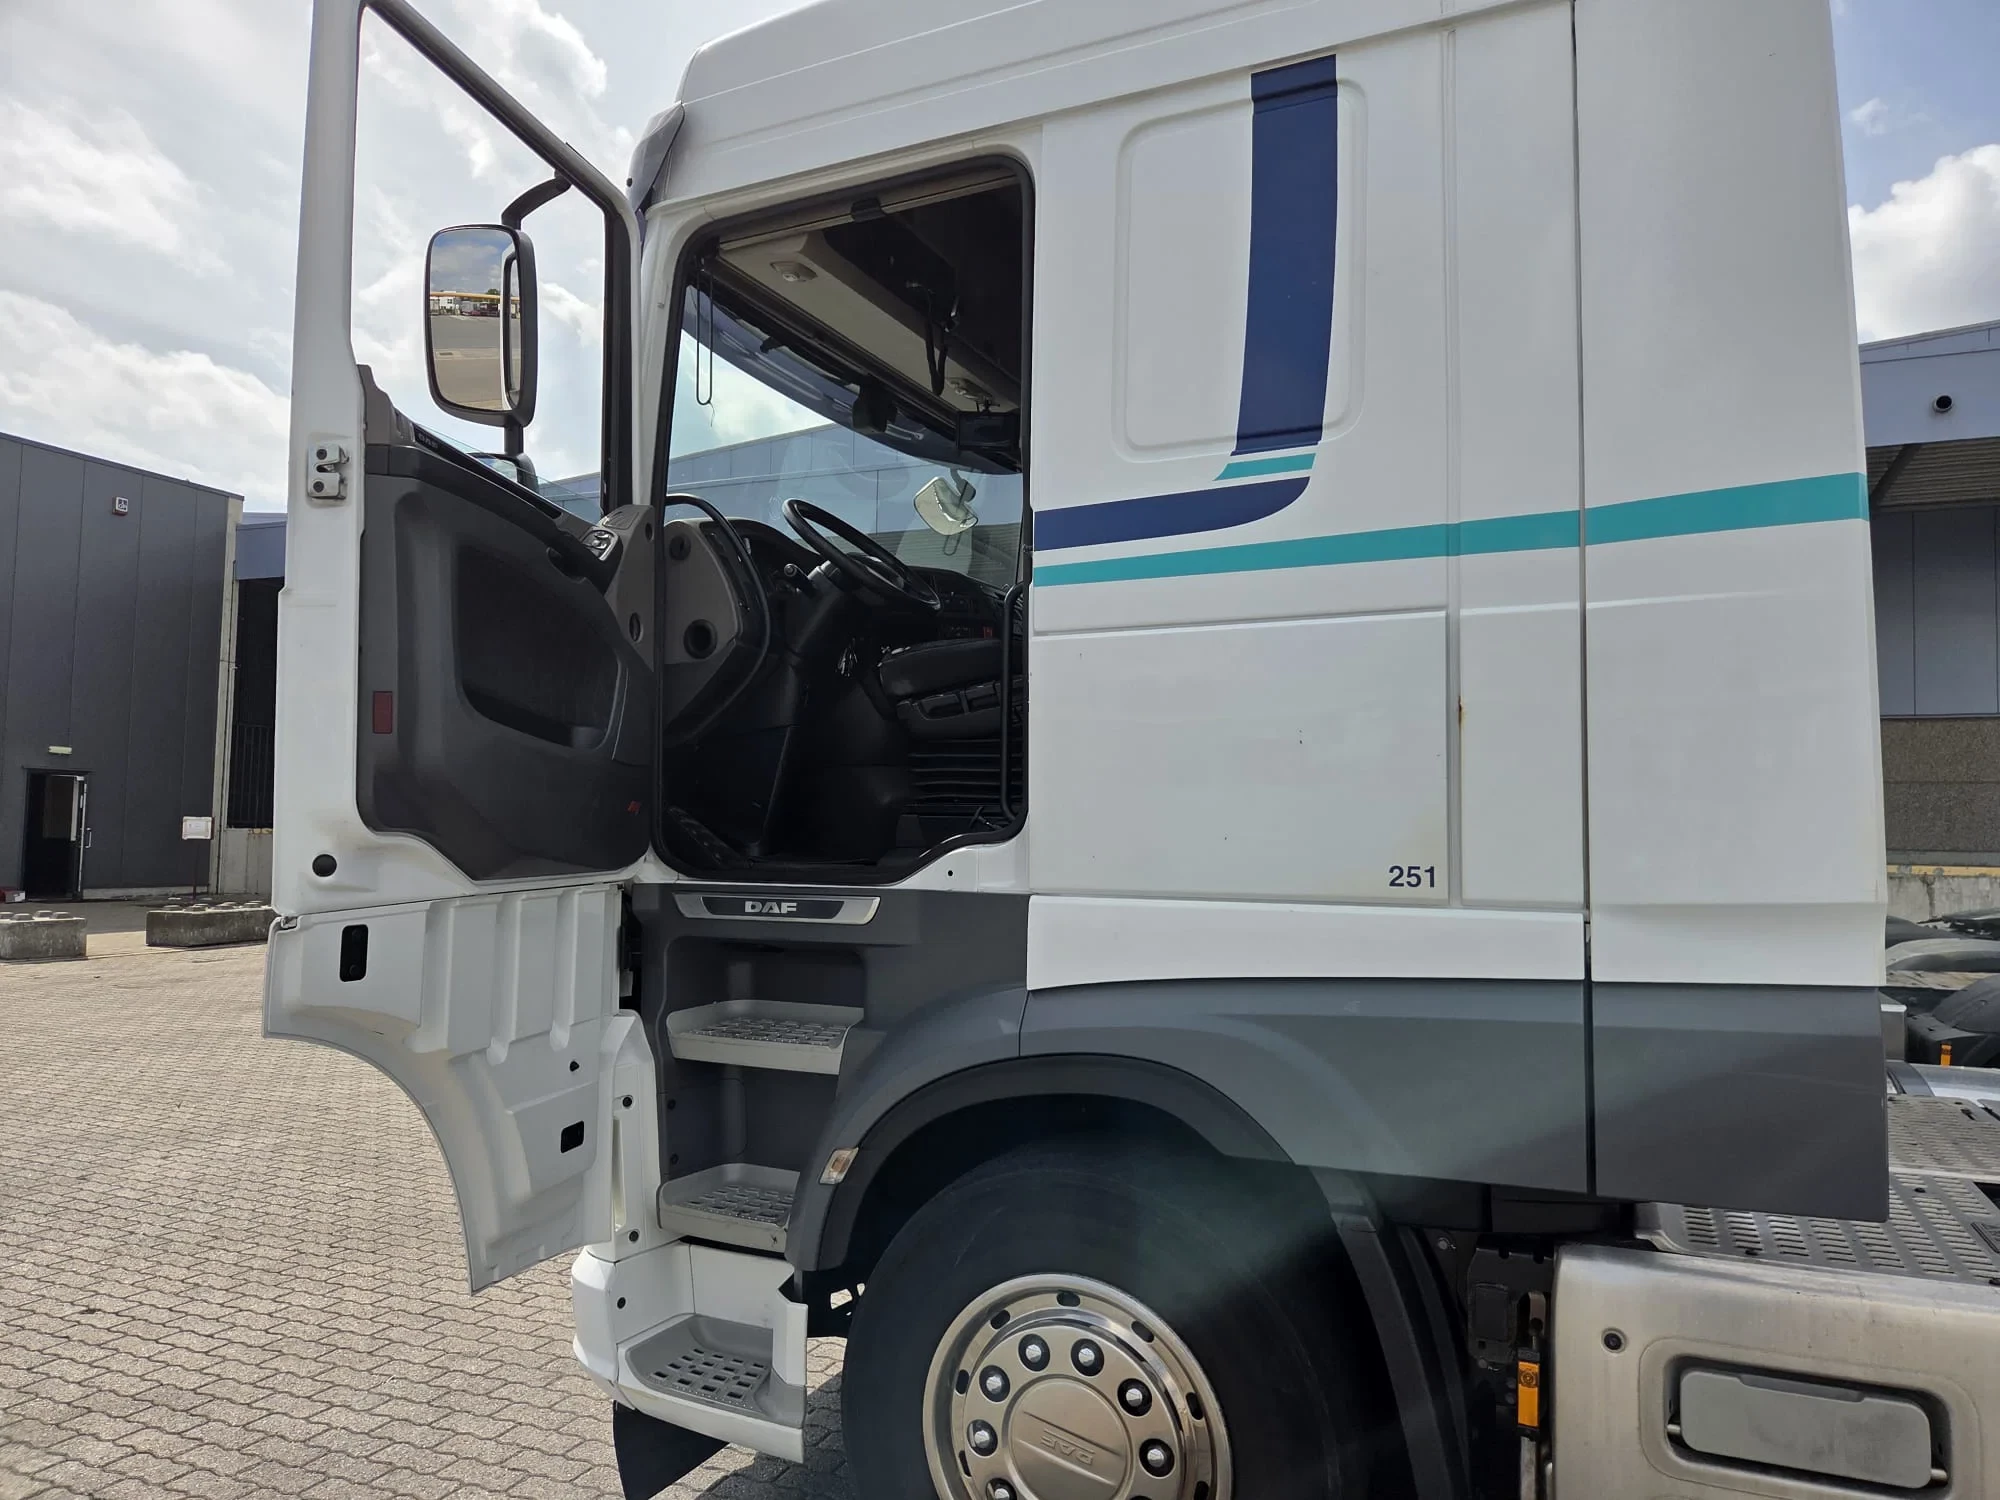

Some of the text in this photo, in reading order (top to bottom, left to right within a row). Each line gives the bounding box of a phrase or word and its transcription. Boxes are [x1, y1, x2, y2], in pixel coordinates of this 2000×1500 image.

[1388, 865, 1435, 888] 251
[744, 900, 798, 914] DAF
[1040, 1432, 1095, 1466] DAF
